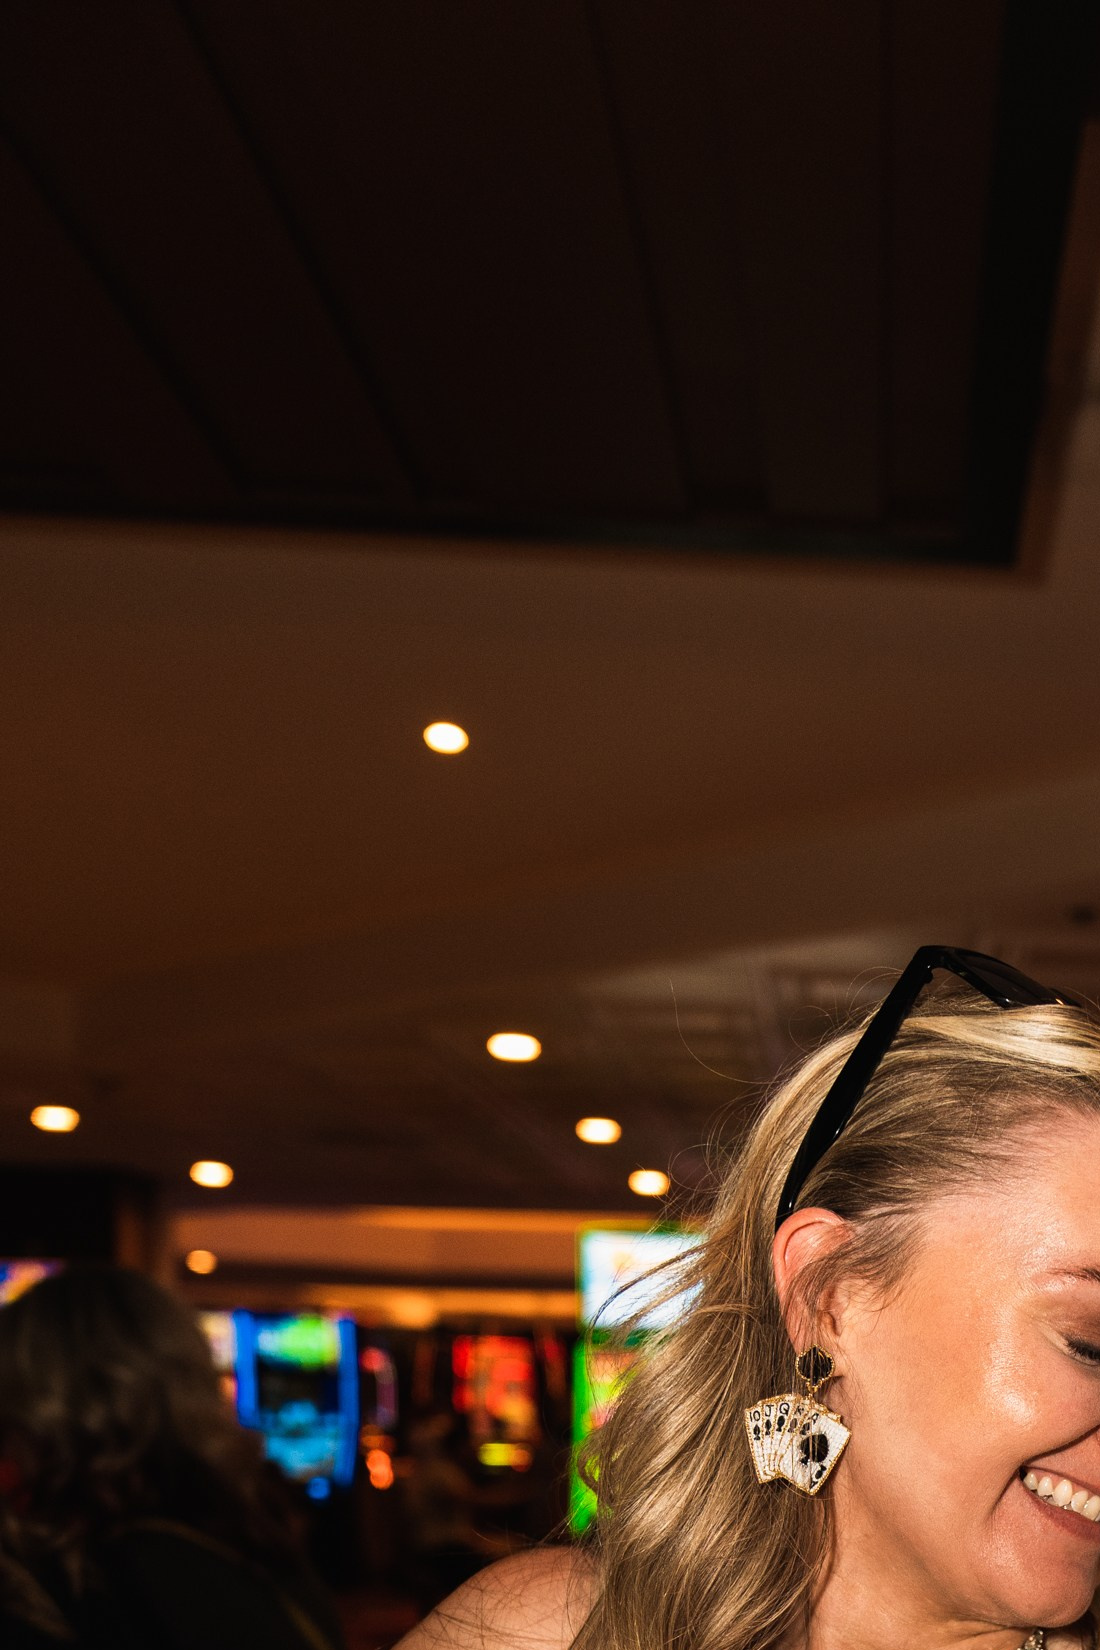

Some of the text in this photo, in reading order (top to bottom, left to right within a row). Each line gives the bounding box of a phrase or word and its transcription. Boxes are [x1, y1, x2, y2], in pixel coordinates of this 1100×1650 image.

[750, 1410, 761, 1422] 10
[764, 1404, 774, 1417] J
[779, 1402, 790, 1416] Q
